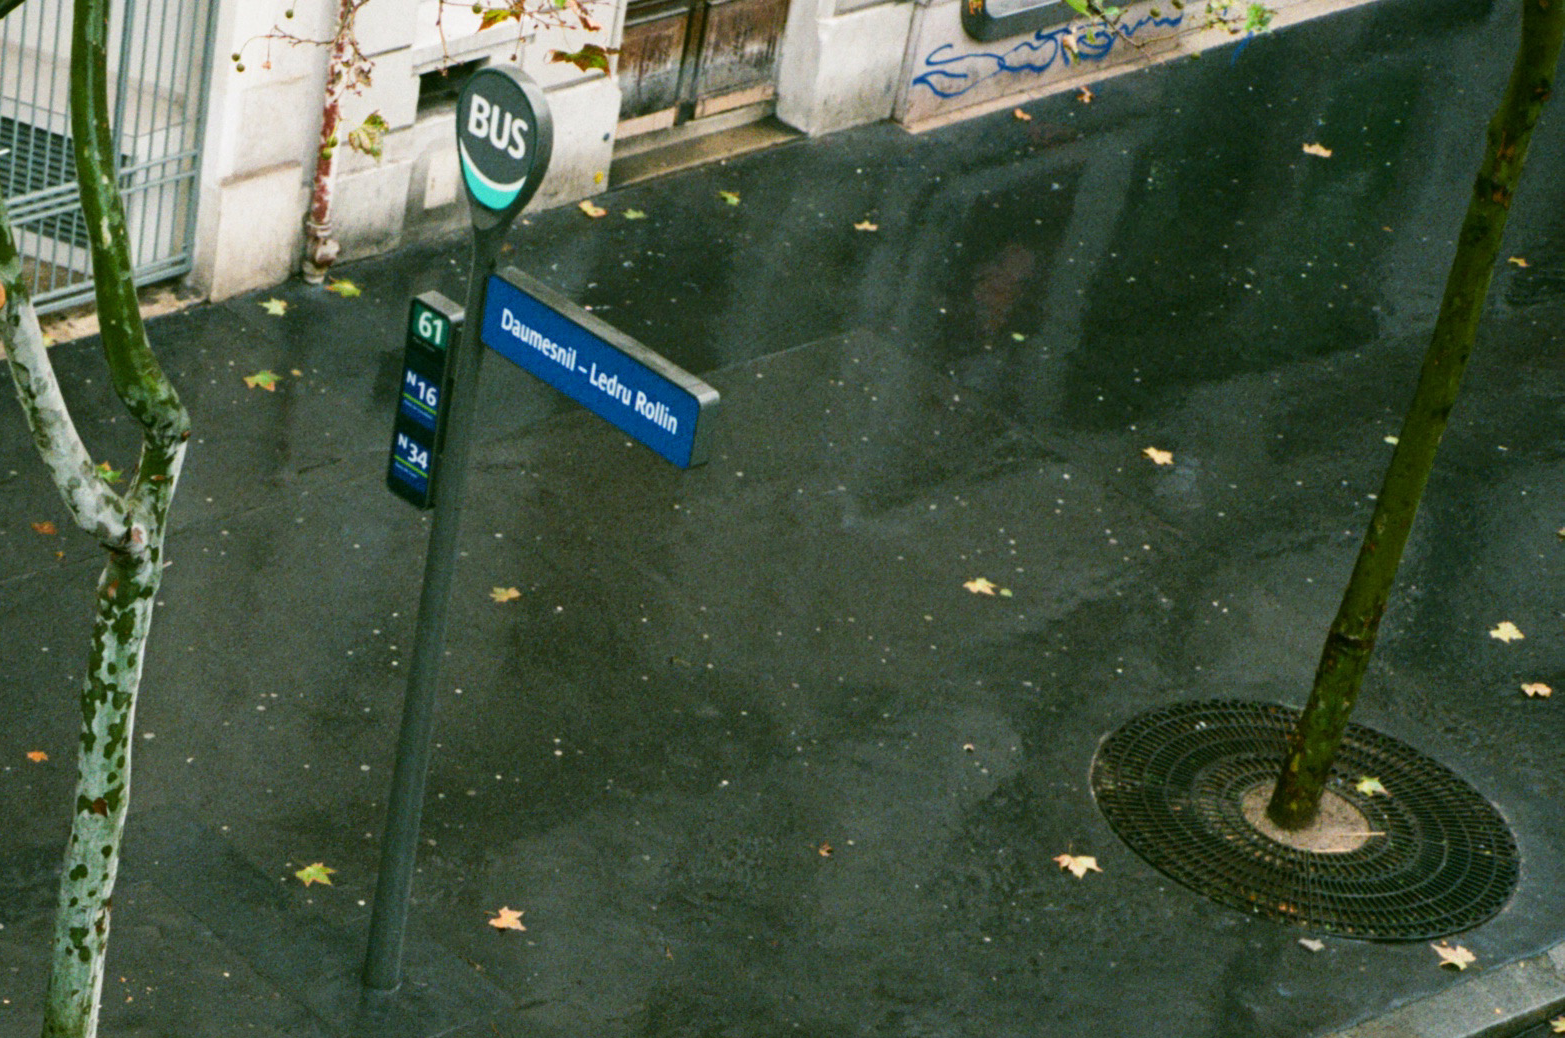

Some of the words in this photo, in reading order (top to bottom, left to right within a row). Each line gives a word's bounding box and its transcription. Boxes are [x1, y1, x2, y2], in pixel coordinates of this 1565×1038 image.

[467, 93, 529, 160] BUS
[418, 311, 443, 345] 61
[501, 308, 577, 371] Daumesnil
[589, 362, 633, 406] Ledru
[635, 391, 678, 435] Rollin
